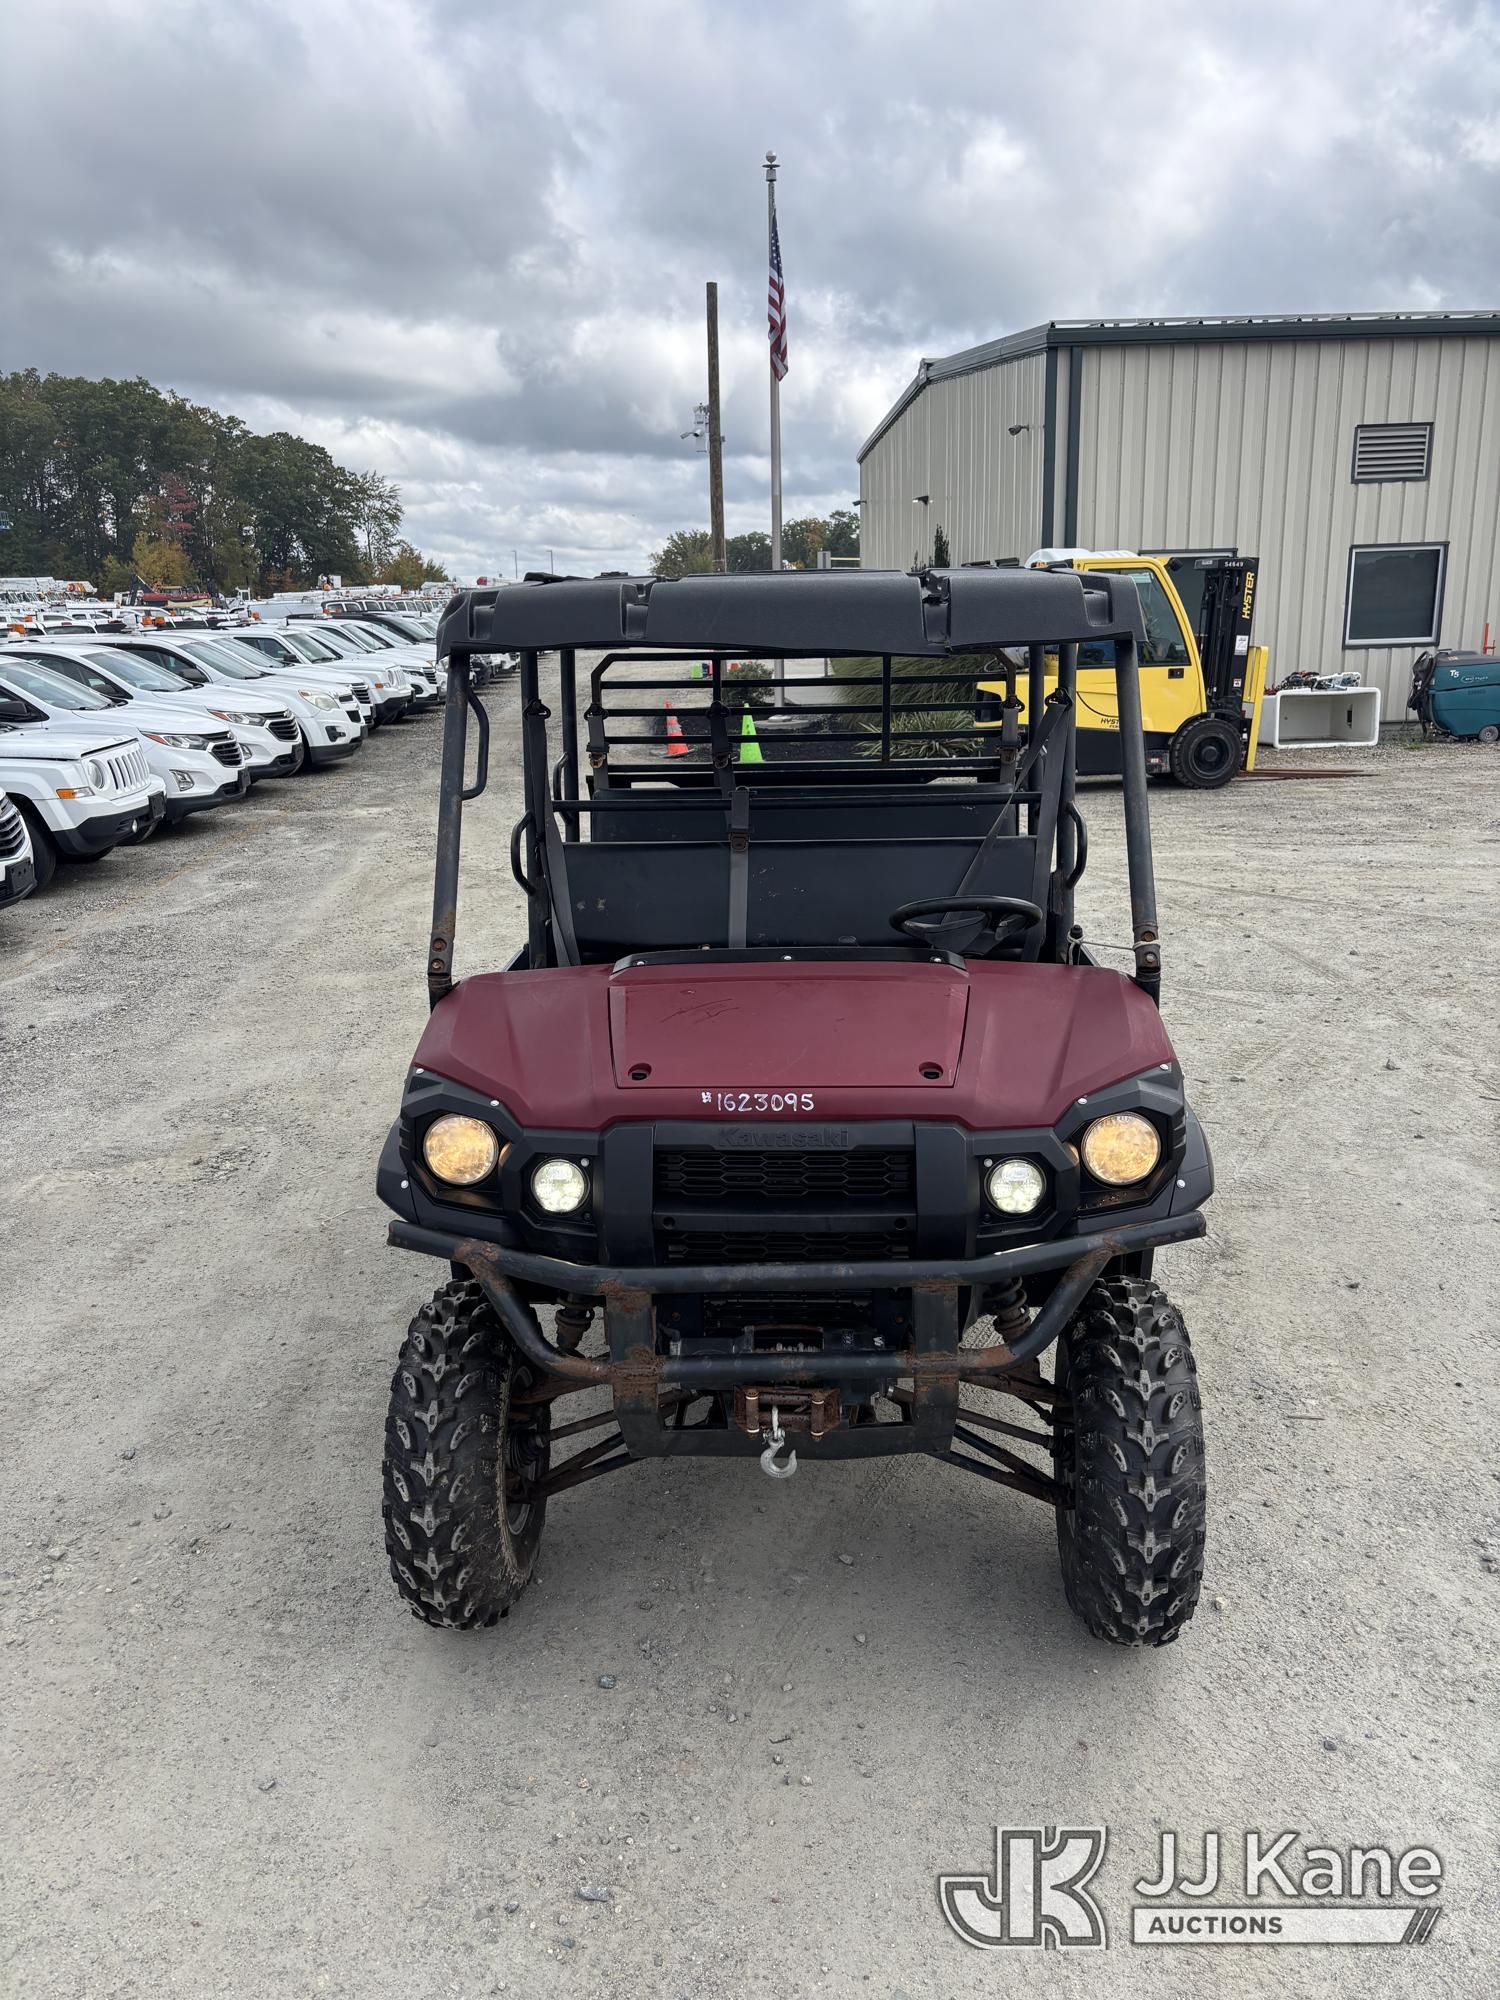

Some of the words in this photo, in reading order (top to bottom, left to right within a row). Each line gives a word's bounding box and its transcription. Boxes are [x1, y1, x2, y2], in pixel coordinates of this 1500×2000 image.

[1241, 571, 1255, 620] HYSTER
[1449, 669, 1460, 678] T5
[1100, 717, 1119, 725] HYST
[718, 1127, 848, 1147] Kawasaki
